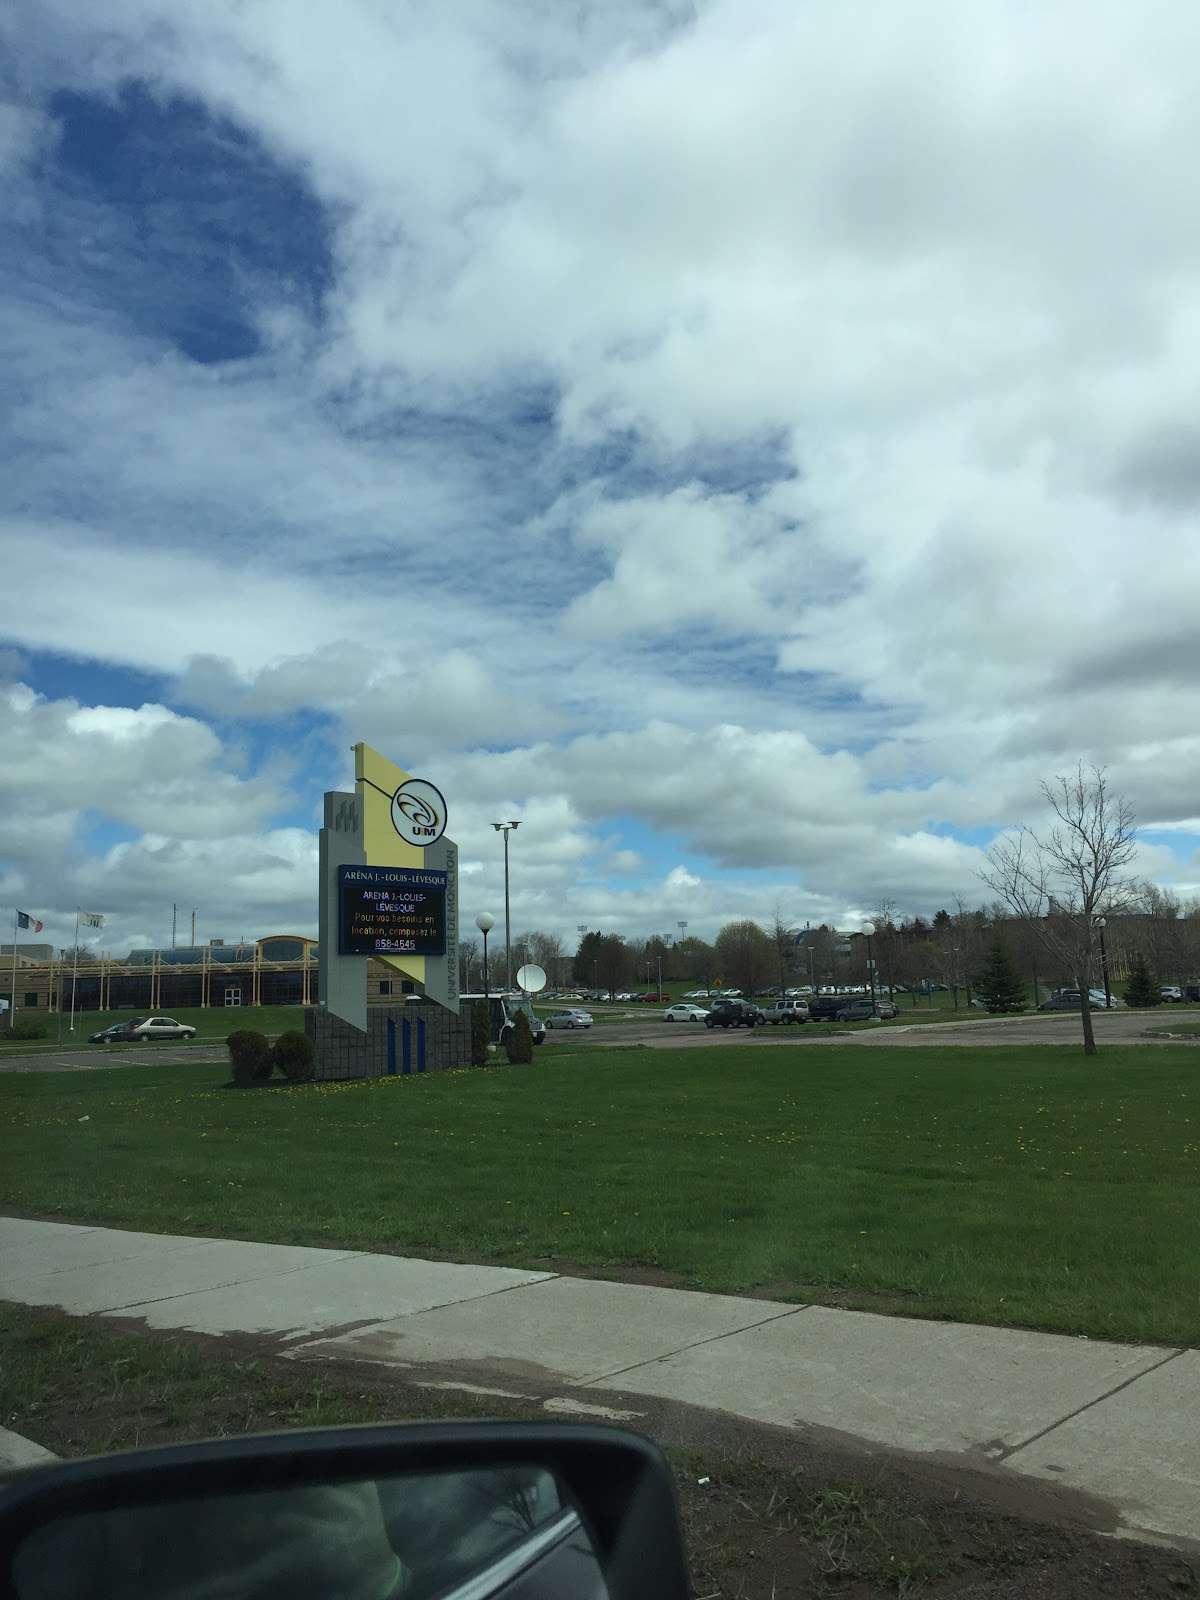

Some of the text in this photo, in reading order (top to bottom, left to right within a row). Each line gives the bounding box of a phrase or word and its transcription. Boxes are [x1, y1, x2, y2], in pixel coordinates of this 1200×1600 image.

[344, 870, 373, 880] ARÉNA
[446, 850, 455, 913] MONCTON
[376, 901, 415, 913] LÉVESQUE
[355, 912, 375, 922] Pour
[392, 913, 422, 923] besoins
[424, 916, 435, 924] en
[447, 915, 456, 930] DE
[351, 926, 387, 937] location,
[389, 928, 428, 938] composez
